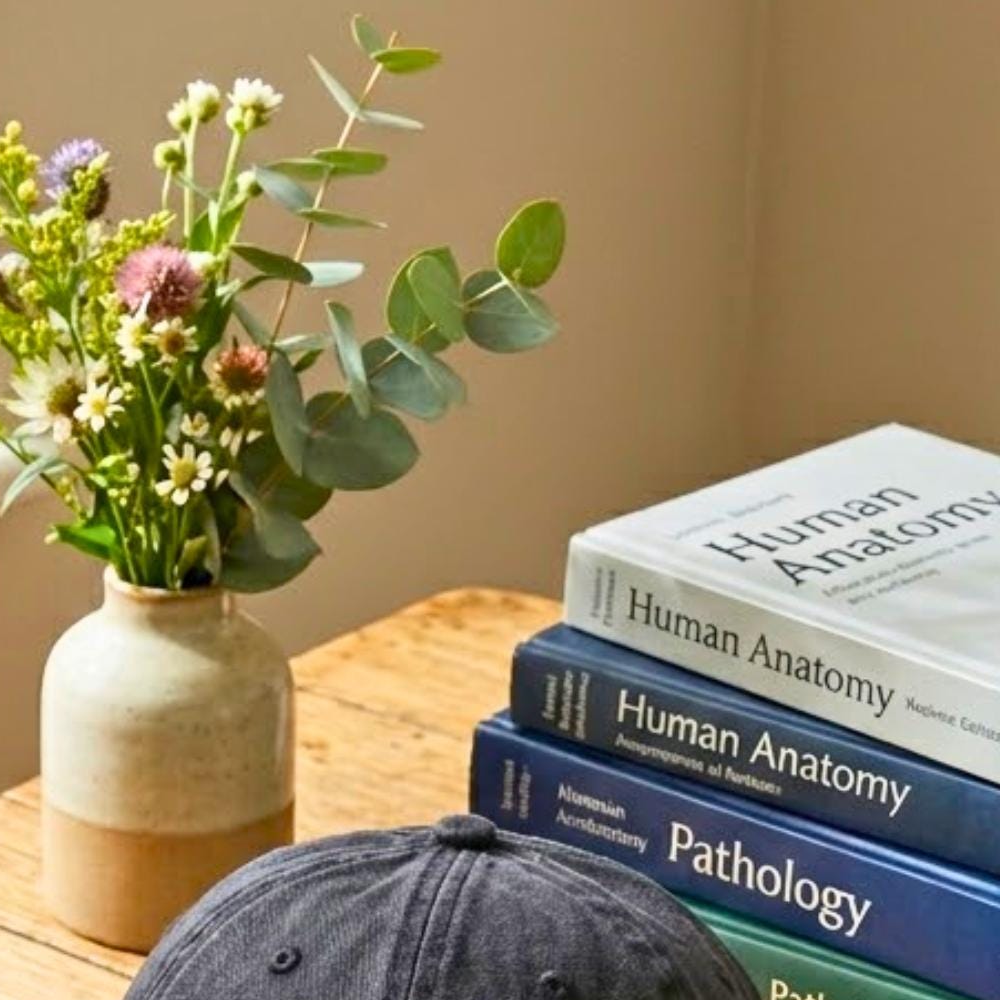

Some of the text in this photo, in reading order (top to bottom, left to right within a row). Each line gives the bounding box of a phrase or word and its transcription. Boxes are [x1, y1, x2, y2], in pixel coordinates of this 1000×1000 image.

[704, 486, 919, 562] Human
[773, 490, 1000, 587] Anatomy
[627, 587, 740, 657] Human
[748, 634, 895, 718] Anatomy
[616, 689, 740, 758] Human
[749, 731, 912, 818] Anatomy
[667, 821, 872, 937] Pathology
